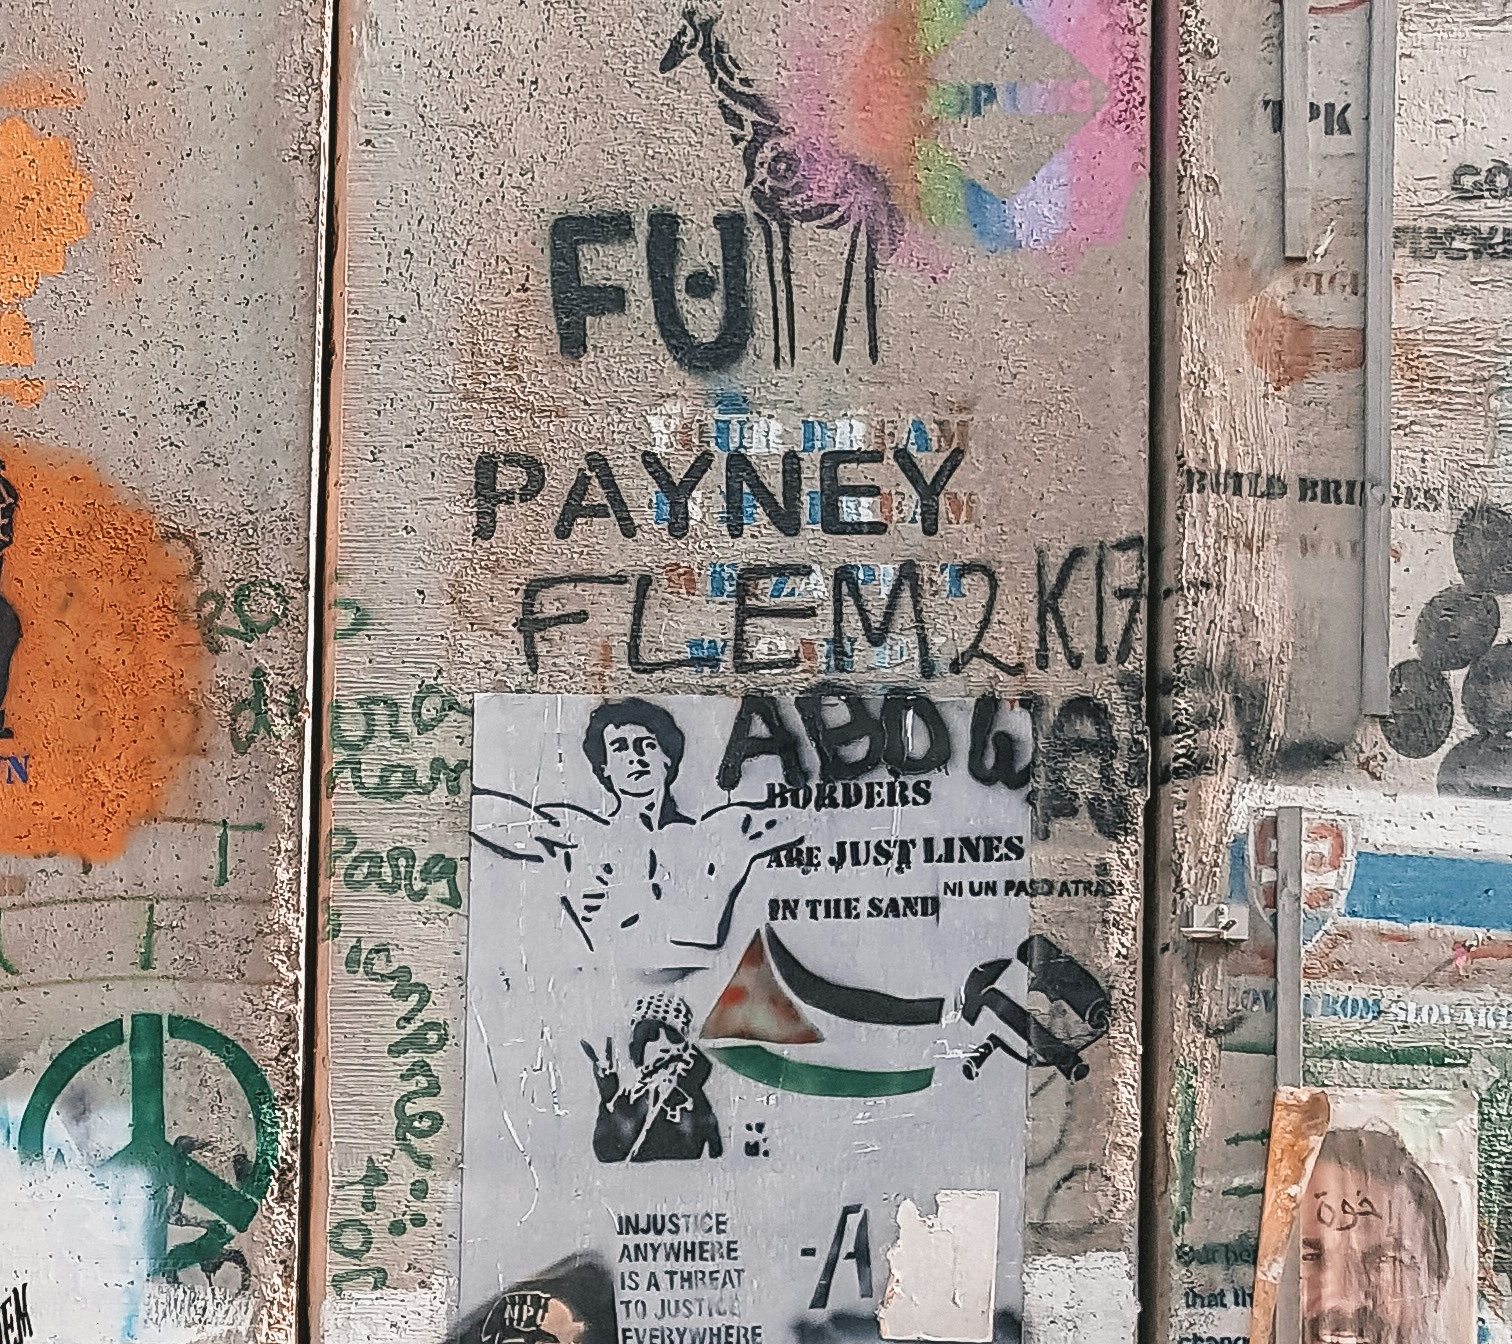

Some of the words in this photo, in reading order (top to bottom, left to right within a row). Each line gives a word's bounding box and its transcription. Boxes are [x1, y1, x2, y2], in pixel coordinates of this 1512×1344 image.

[550, 210, 752, 373] FU
[471, 449, 965, 540] PAYNEY
[765, 779, 933, 809] BORDERS
[766, 842, 822, 869] ARE
[828, 837, 917, 872] JUST
[923, 834, 1027, 865] LINES
[767, 897, 799, 921] IN
[805, 896, 862, 920] THE
[866, 895, 938, 920] SAND
[617, 1213, 728, 1236] INJUSTICE
[619, 1240, 739, 1263] ANYWHERE
[620, 1271, 640, 1291] IS
[645, 1269, 661, 1292] A
[664, 1268, 745, 1290] THREAT
[620, 1301, 648, 1320] TO
[653, 1299, 741, 1320] JUSTICE
